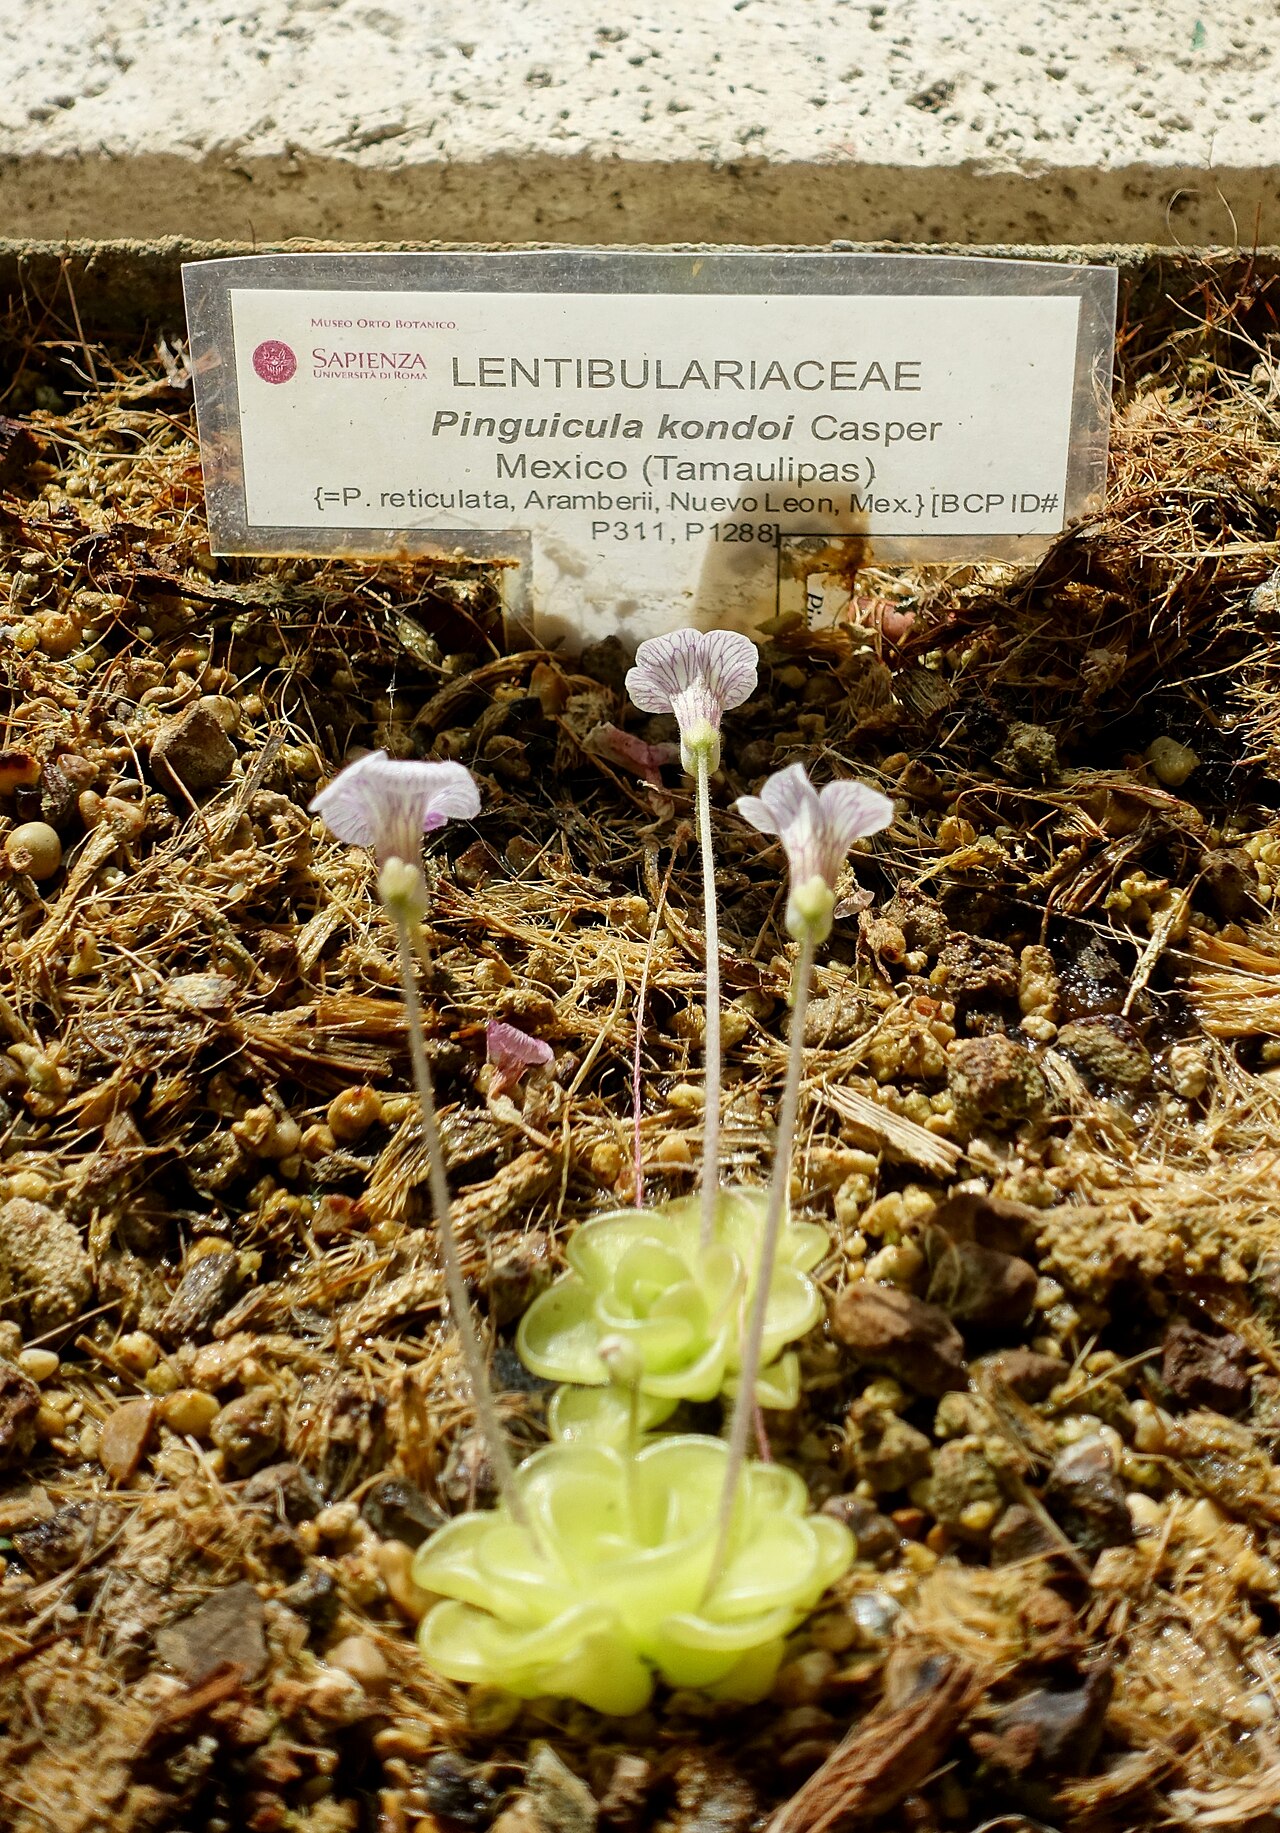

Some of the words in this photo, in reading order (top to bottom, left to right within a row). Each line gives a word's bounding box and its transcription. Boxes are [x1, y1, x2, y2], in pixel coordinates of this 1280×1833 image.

[452, 356, 922, 392] LENTIBULARIACEAE
[431, 410, 644, 445] Pinguicula
[657, 413, 795, 441] kondoi
[810, 414, 943, 448] Casper
[496, 453, 628, 480] Mexico
[642, 455, 877, 488] (Tamaulipas)
[380, 489, 516, 511] reticulata,
[524, 490, 661, 513] Aramberii,
[670, 492, 759, 513] Nuevo
[764, 493, 840, 516] Leon,
[850, 493, 925, 518] Mex.}
[592, 521, 676, 544] P311,
[686, 523, 780, 548] P1288]
